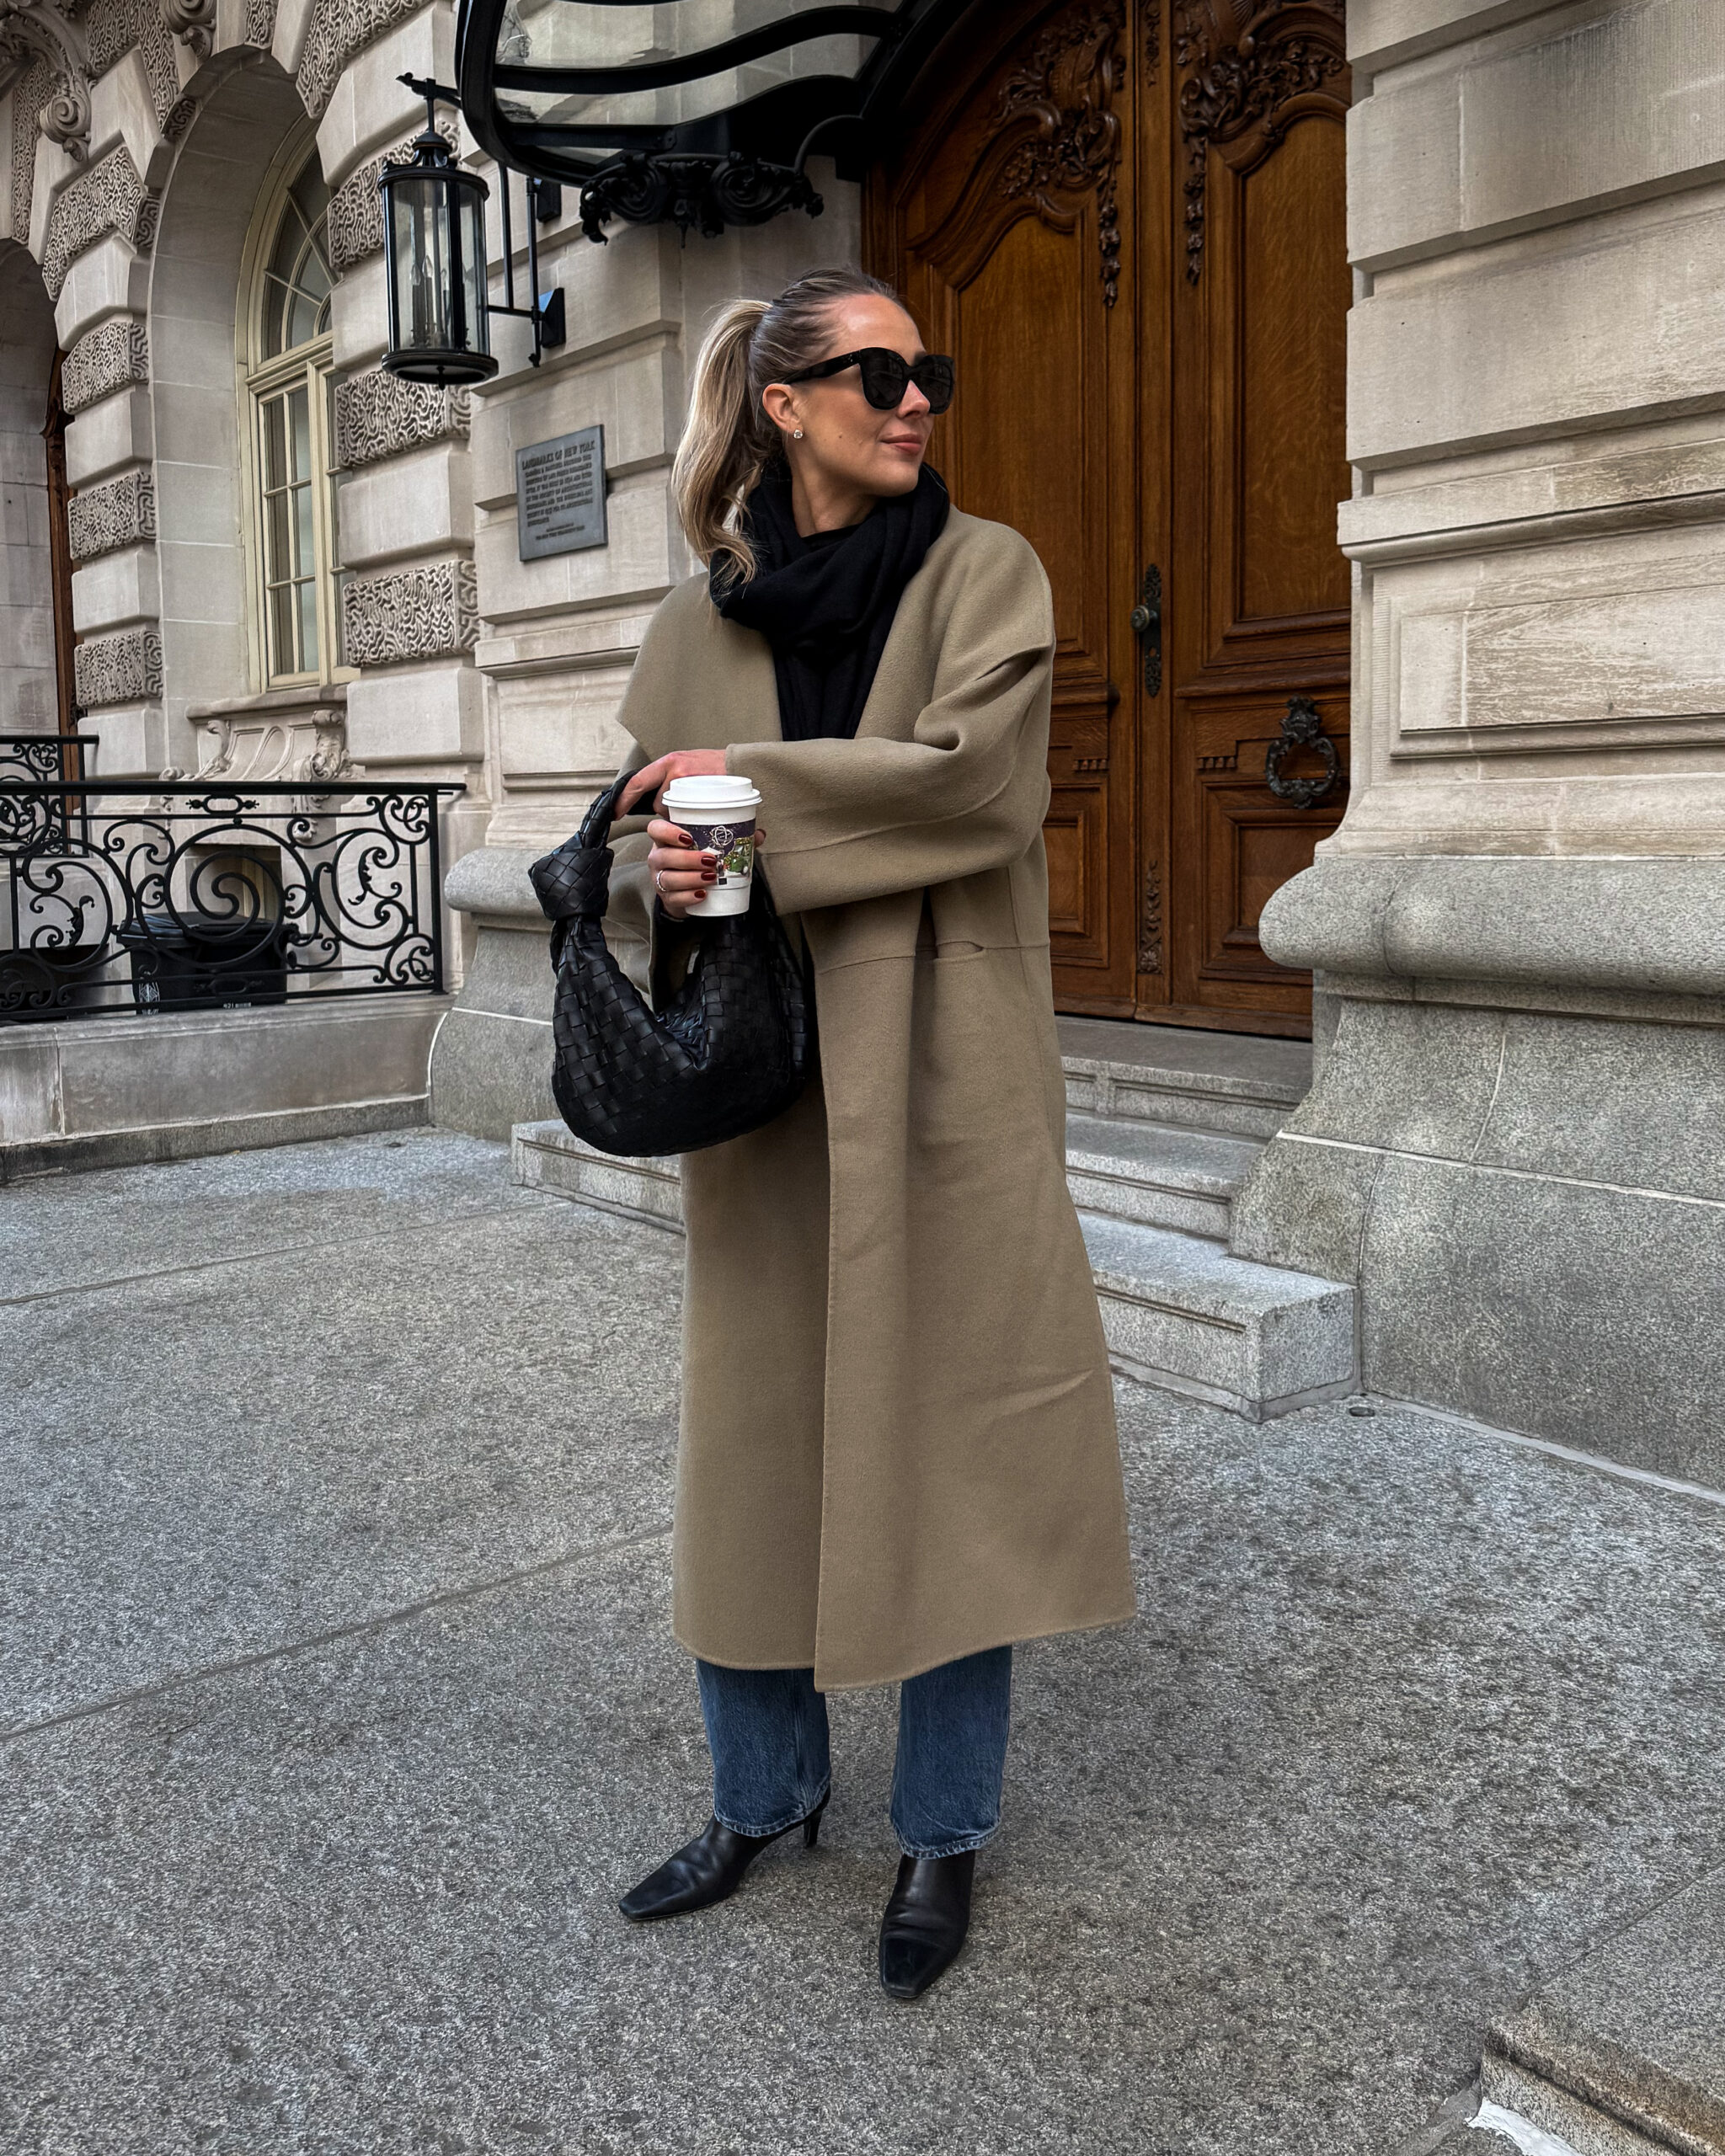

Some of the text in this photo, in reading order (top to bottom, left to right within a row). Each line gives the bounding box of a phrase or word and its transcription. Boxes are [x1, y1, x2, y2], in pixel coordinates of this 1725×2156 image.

[522, 453, 553, 471] LANDMARKS
[554, 450, 563, 461] OF
[564, 446, 578, 457] NEW
[579, 440, 595, 453] YORK
